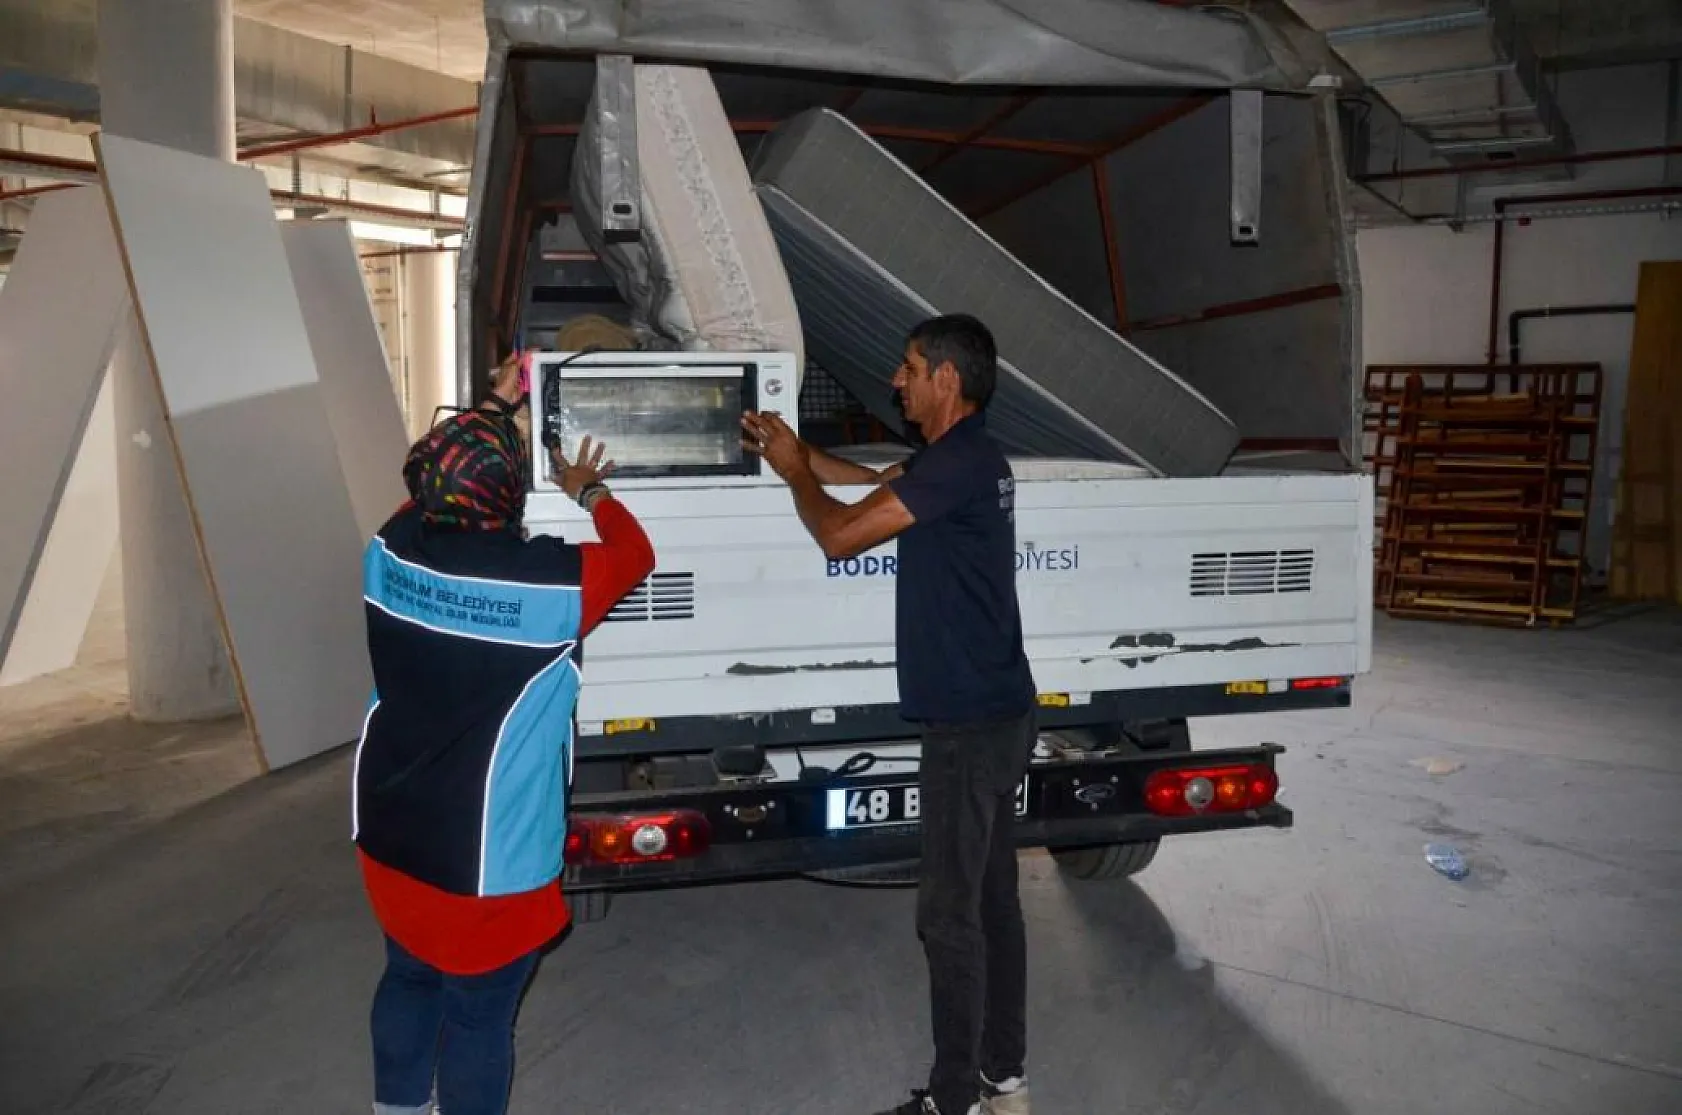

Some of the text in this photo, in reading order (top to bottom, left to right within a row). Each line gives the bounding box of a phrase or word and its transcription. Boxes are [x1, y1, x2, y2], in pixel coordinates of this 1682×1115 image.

[827, 542, 1079, 577] BODR DİYESİ
[436, 590, 522, 615] BELEDİYESİ
[847, 789, 890, 822] 48
